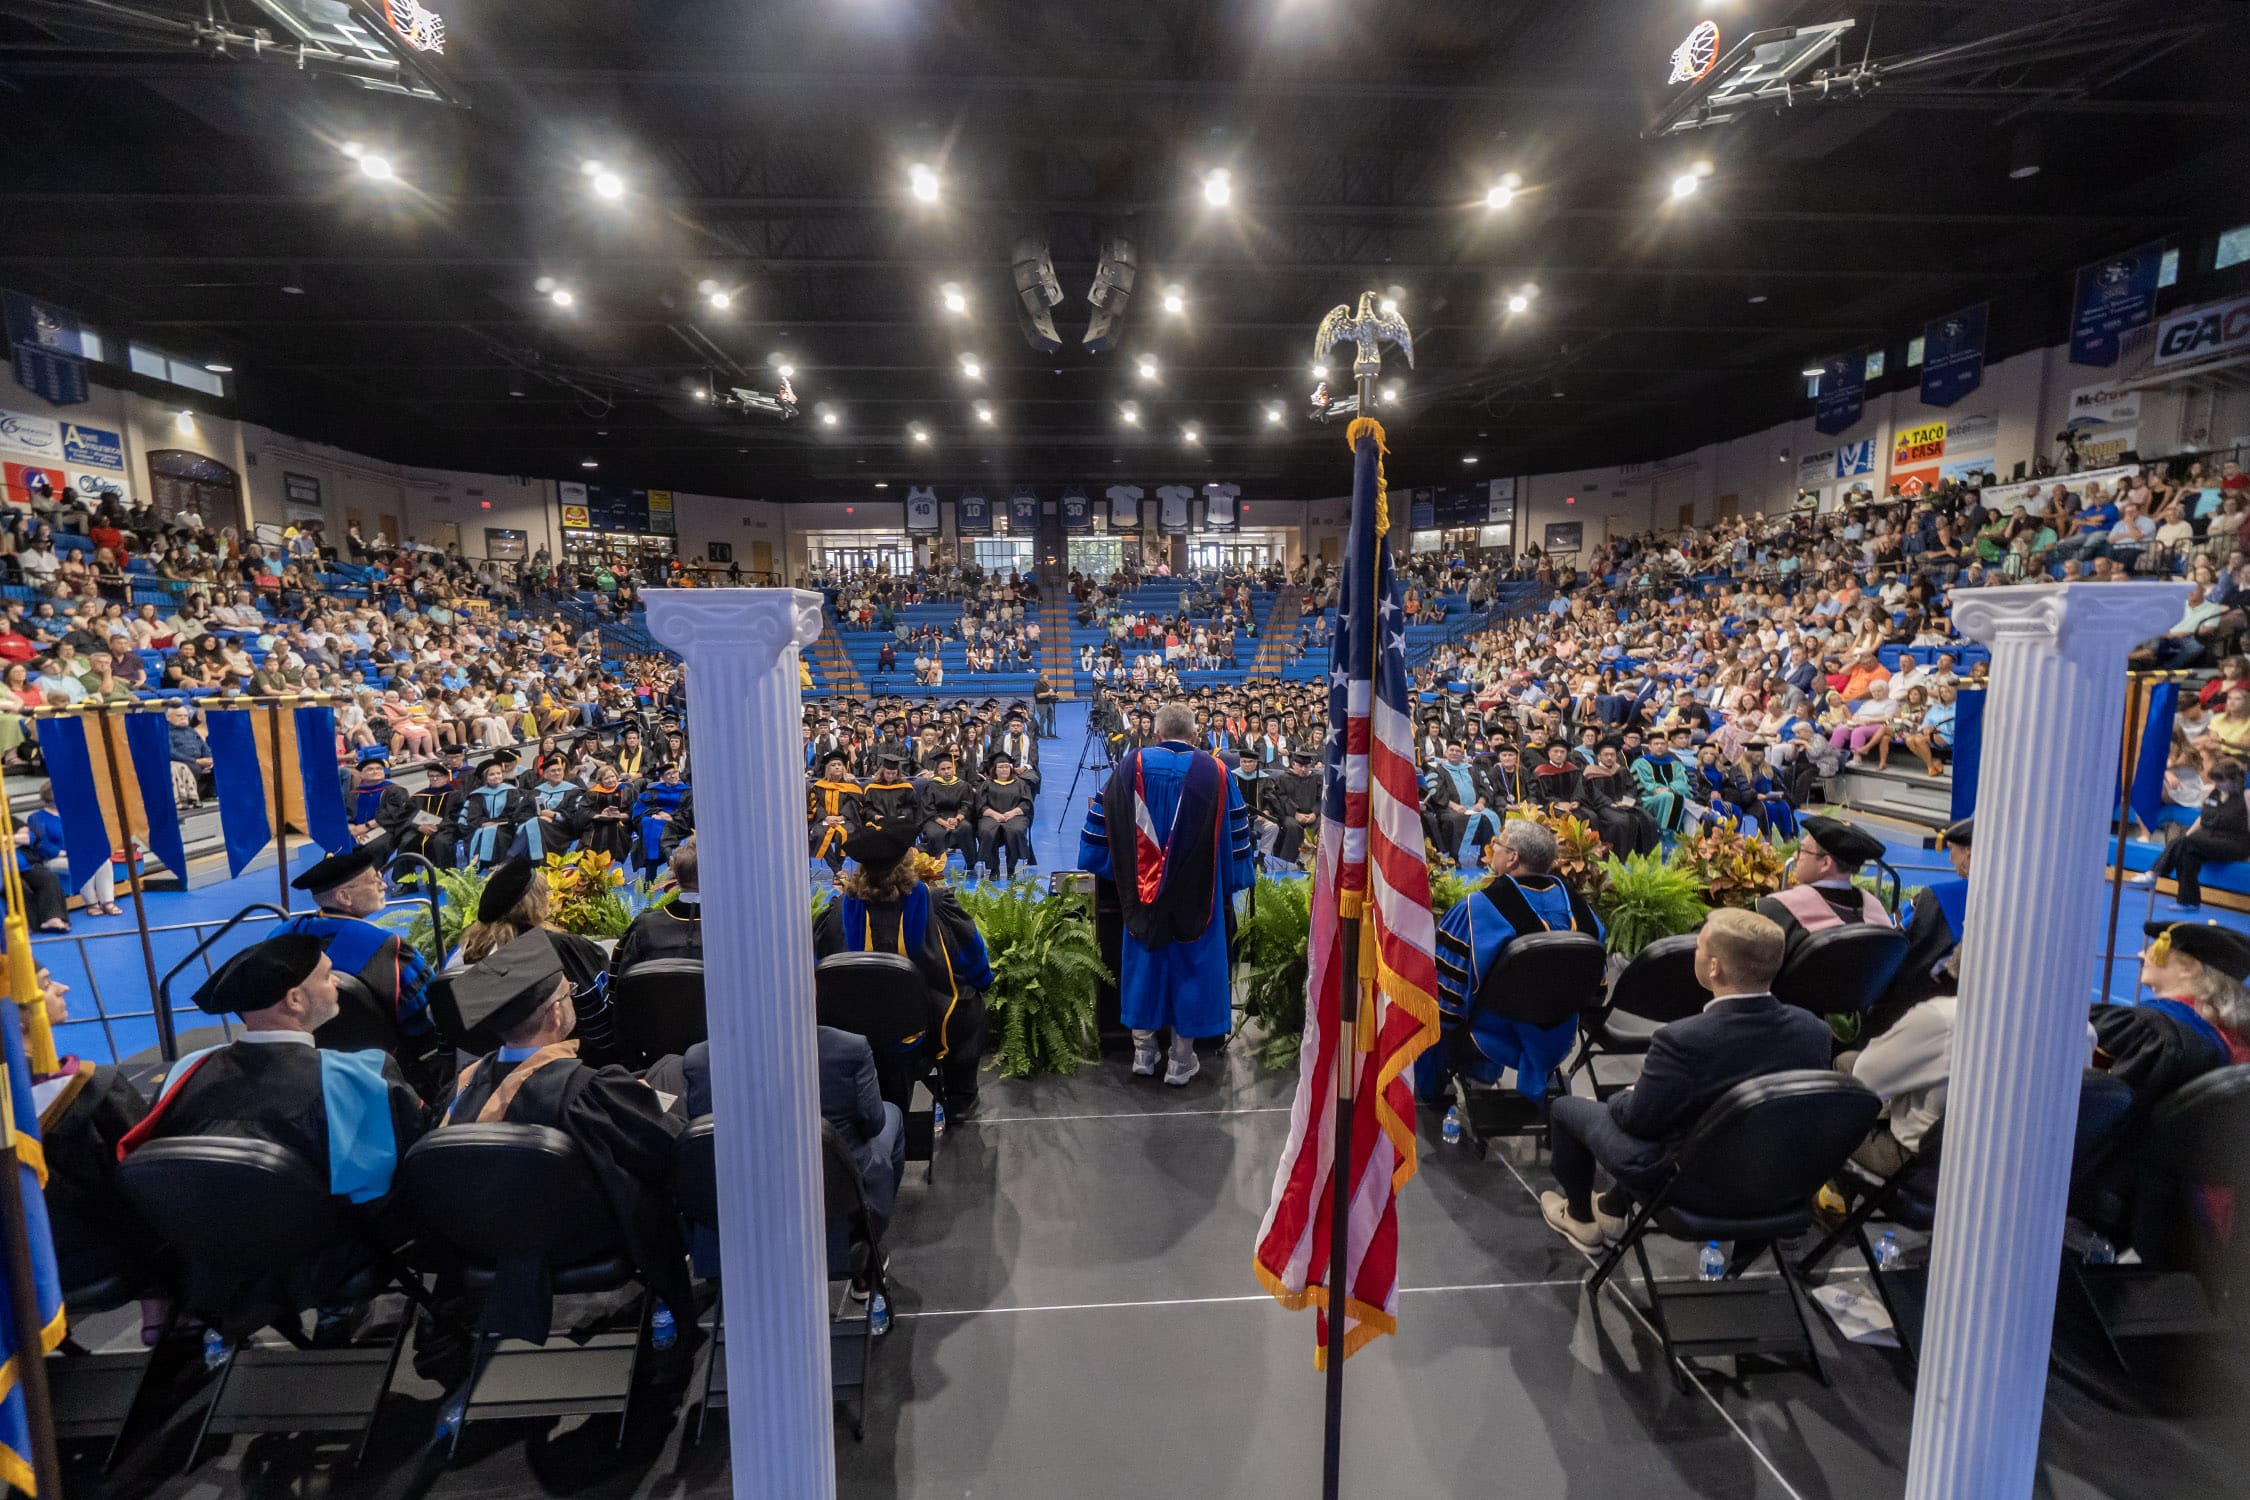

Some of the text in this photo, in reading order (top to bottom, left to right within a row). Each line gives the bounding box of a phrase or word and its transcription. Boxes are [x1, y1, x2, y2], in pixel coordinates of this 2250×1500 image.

[1912, 426, 1944, 444] TACO
[1911, 442, 1943, 459] CASA
[915, 503, 930, 515] 40
[966, 504, 981, 517] 10
[1016, 504, 1032, 517] 34
[1067, 504, 1083, 516] 30
